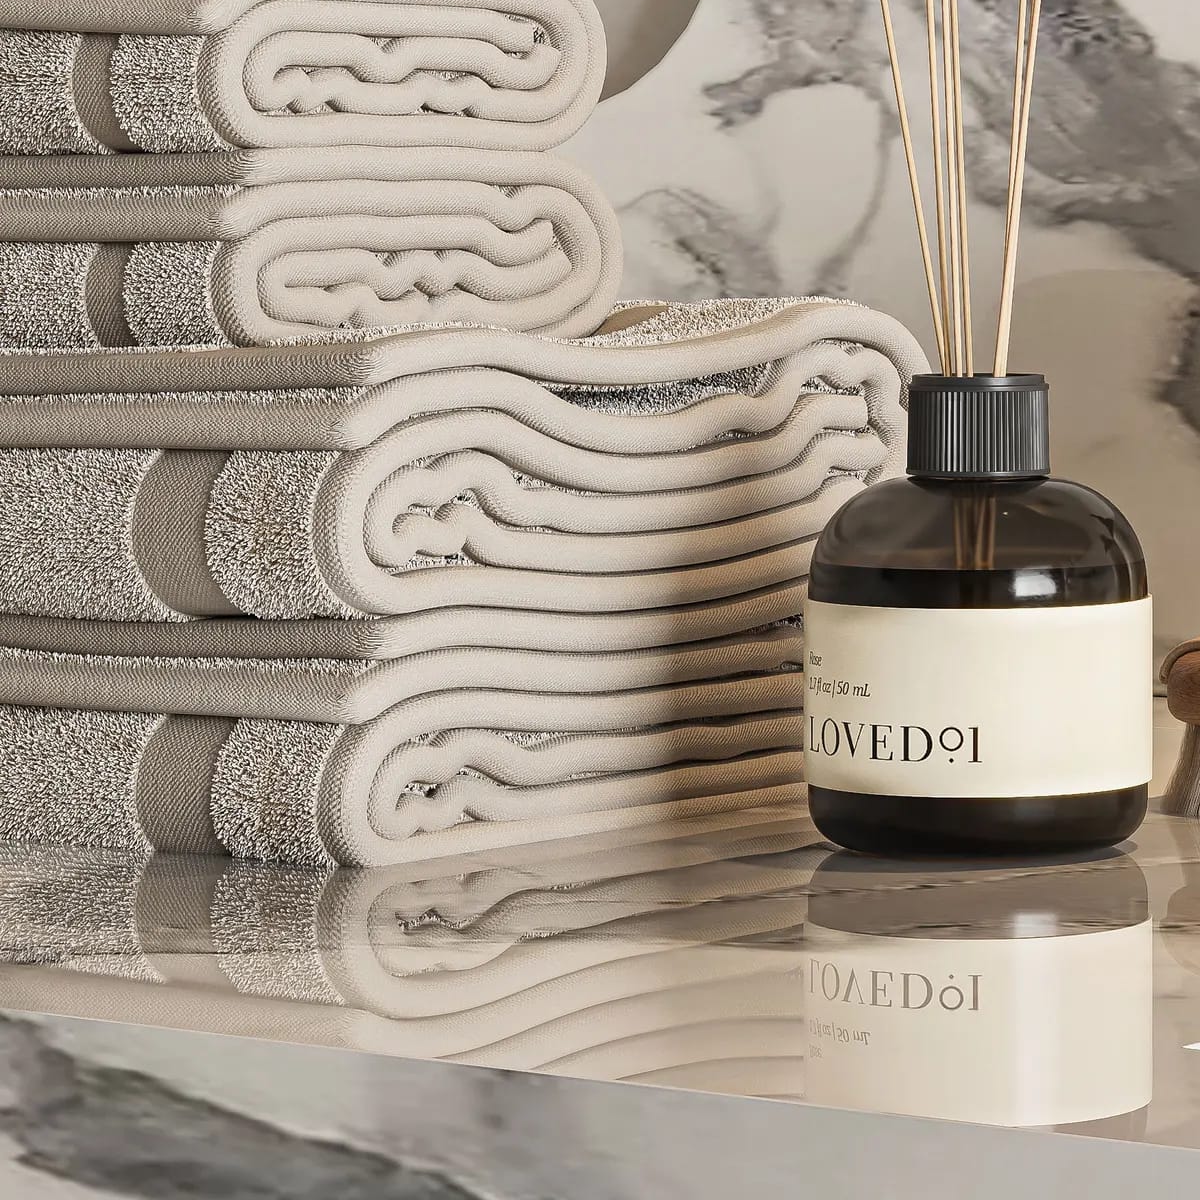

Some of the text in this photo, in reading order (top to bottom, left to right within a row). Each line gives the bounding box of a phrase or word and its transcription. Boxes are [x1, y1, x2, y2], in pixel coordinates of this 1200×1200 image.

[809, 651, 822, 666] Rose
[837, 682, 849, 695] 50
[852, 684, 870, 697] mL
